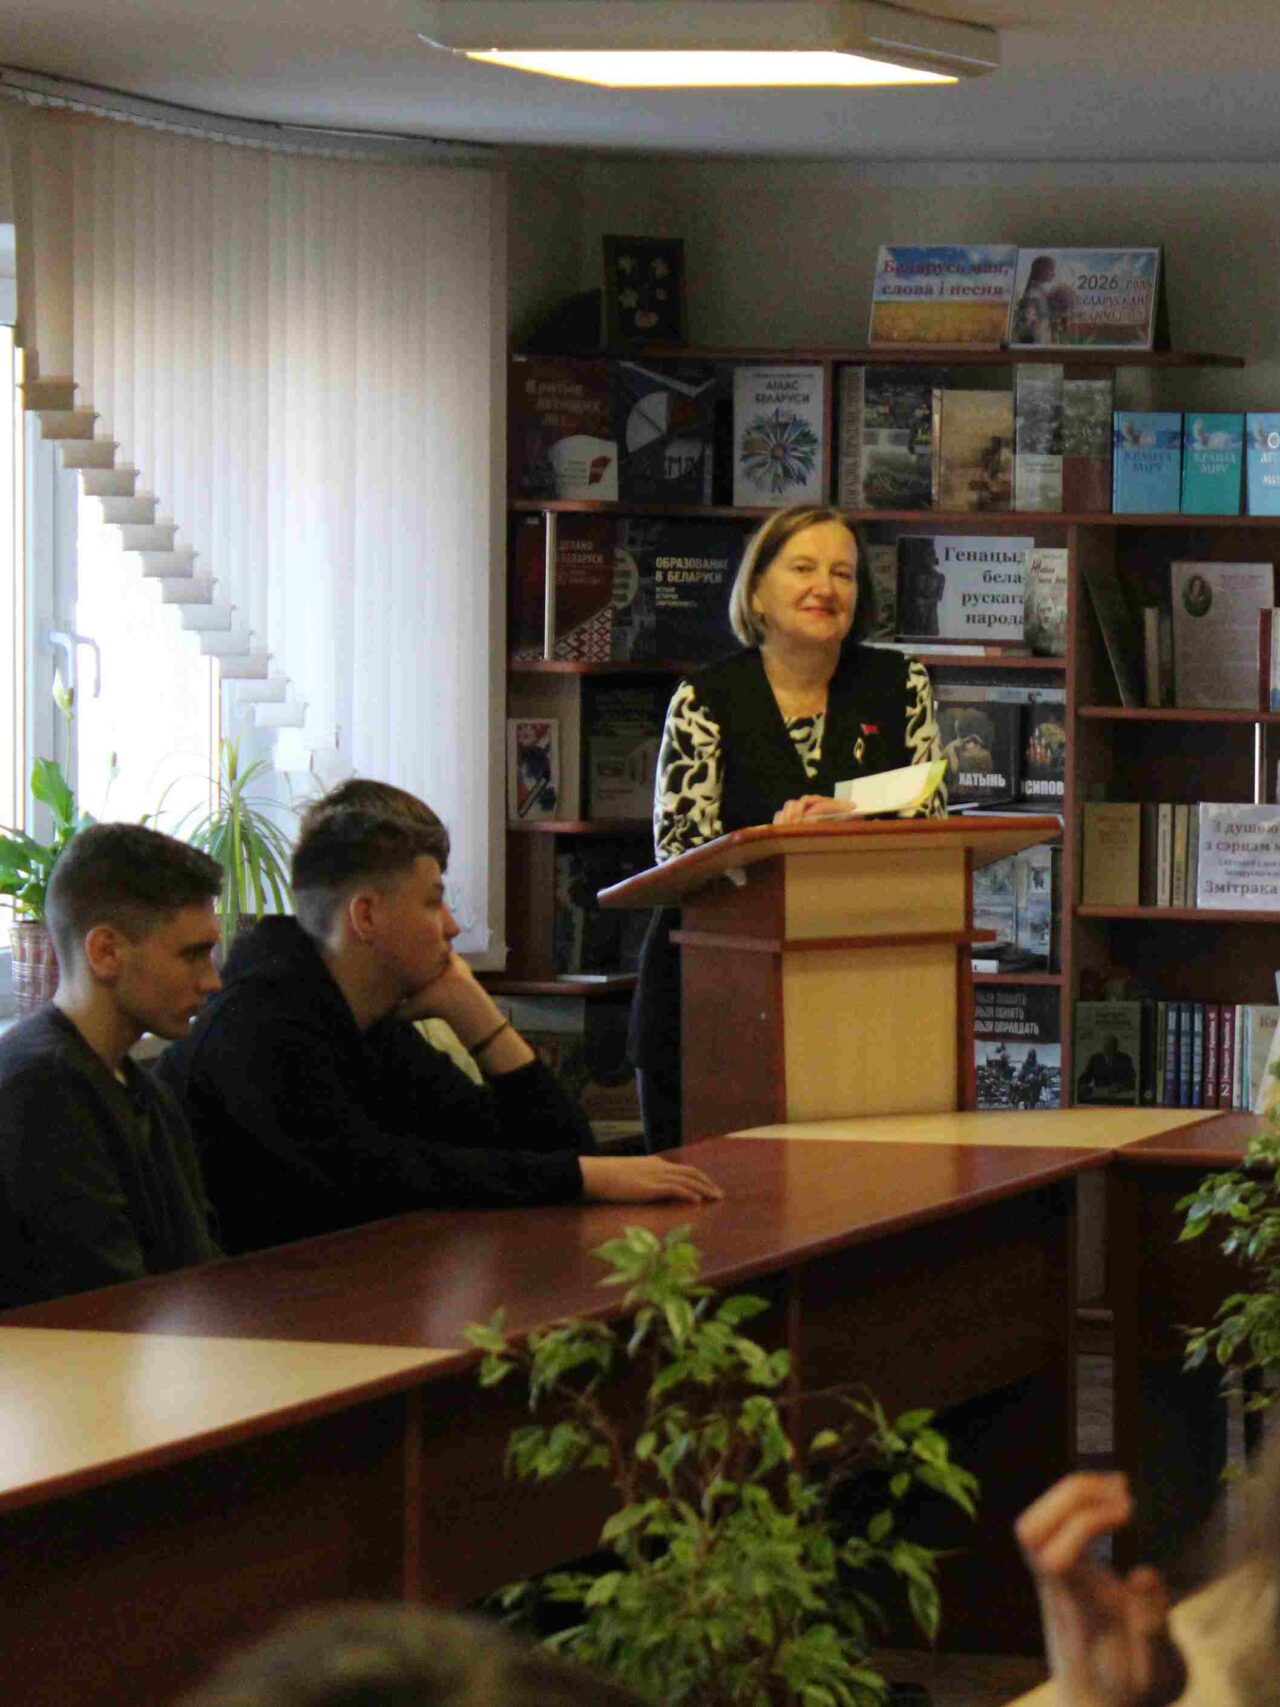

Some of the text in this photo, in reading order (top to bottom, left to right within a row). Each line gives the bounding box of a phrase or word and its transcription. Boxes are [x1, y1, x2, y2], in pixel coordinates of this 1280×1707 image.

[882, 281, 1004, 296] слова і песня
[1077, 274, 1119, 290] 2026
[944, 546, 1025, 564] Генацыд
[655, 556, 729, 570] ОБРАЗОВАНИЕ
[655, 570, 723, 584] В БЕЛАРУСИ
[958, 772, 1006, 788] ХАТЫНЬ
[1225, 822, 1279, 836] душою
[1216, 841, 1270, 854] сэрцам
[1204, 880, 1278, 896] Змітрака
[1207, 1083, 1214, 1097] 1
[1220, 1083, 1230, 1097] 2
